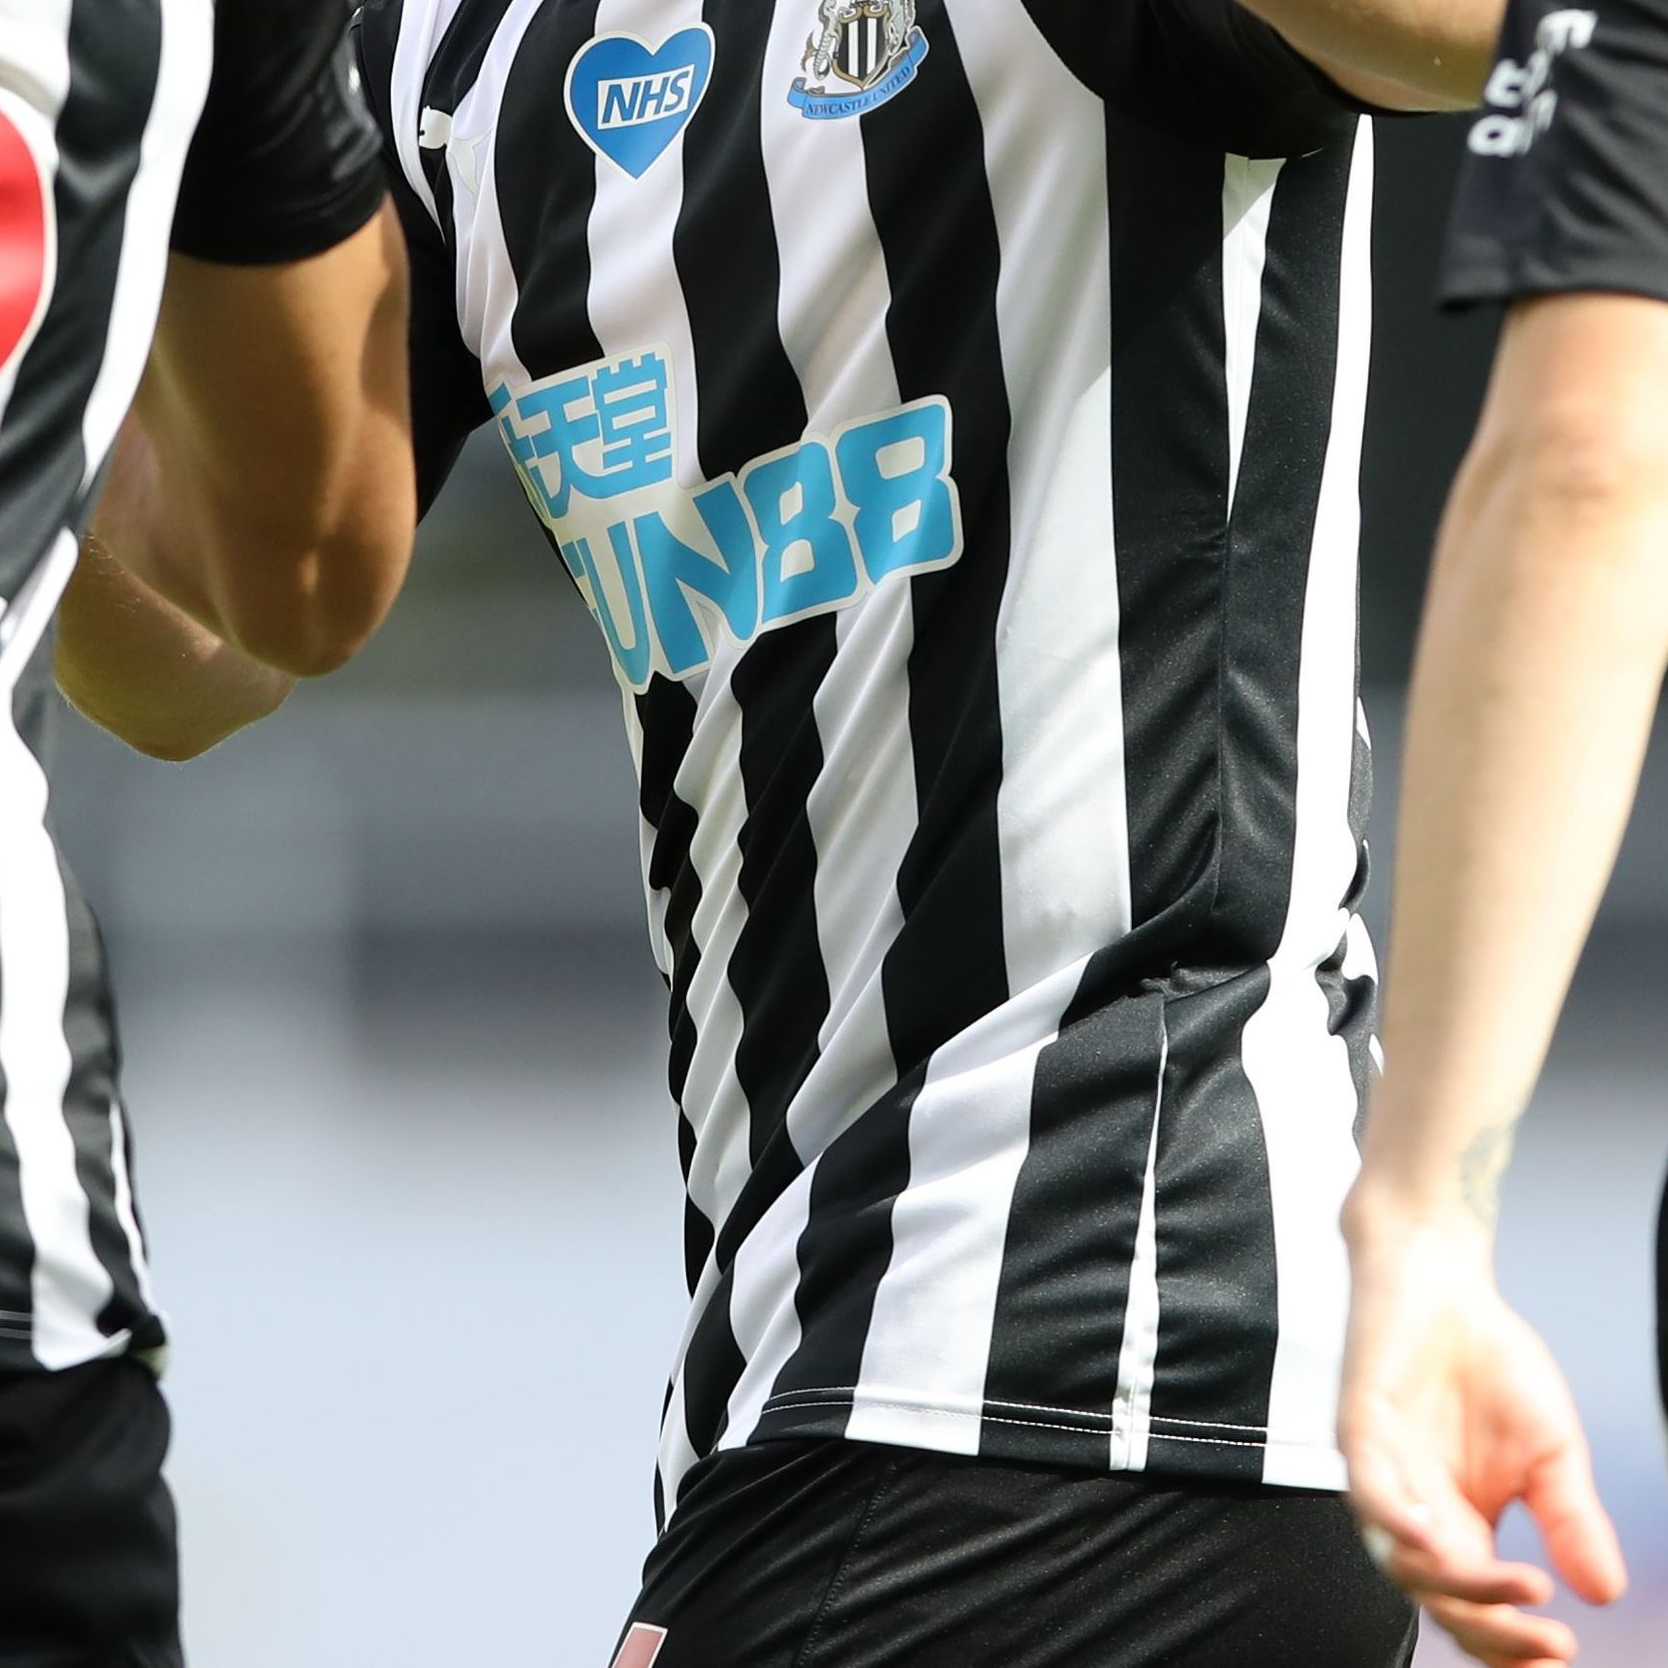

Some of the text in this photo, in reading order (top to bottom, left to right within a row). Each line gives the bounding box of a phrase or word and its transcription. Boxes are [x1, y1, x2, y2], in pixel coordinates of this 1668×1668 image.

[601, 70, 690, 124] NHS
[805, 65, 911, 116] NEWCASTLE UNITED
